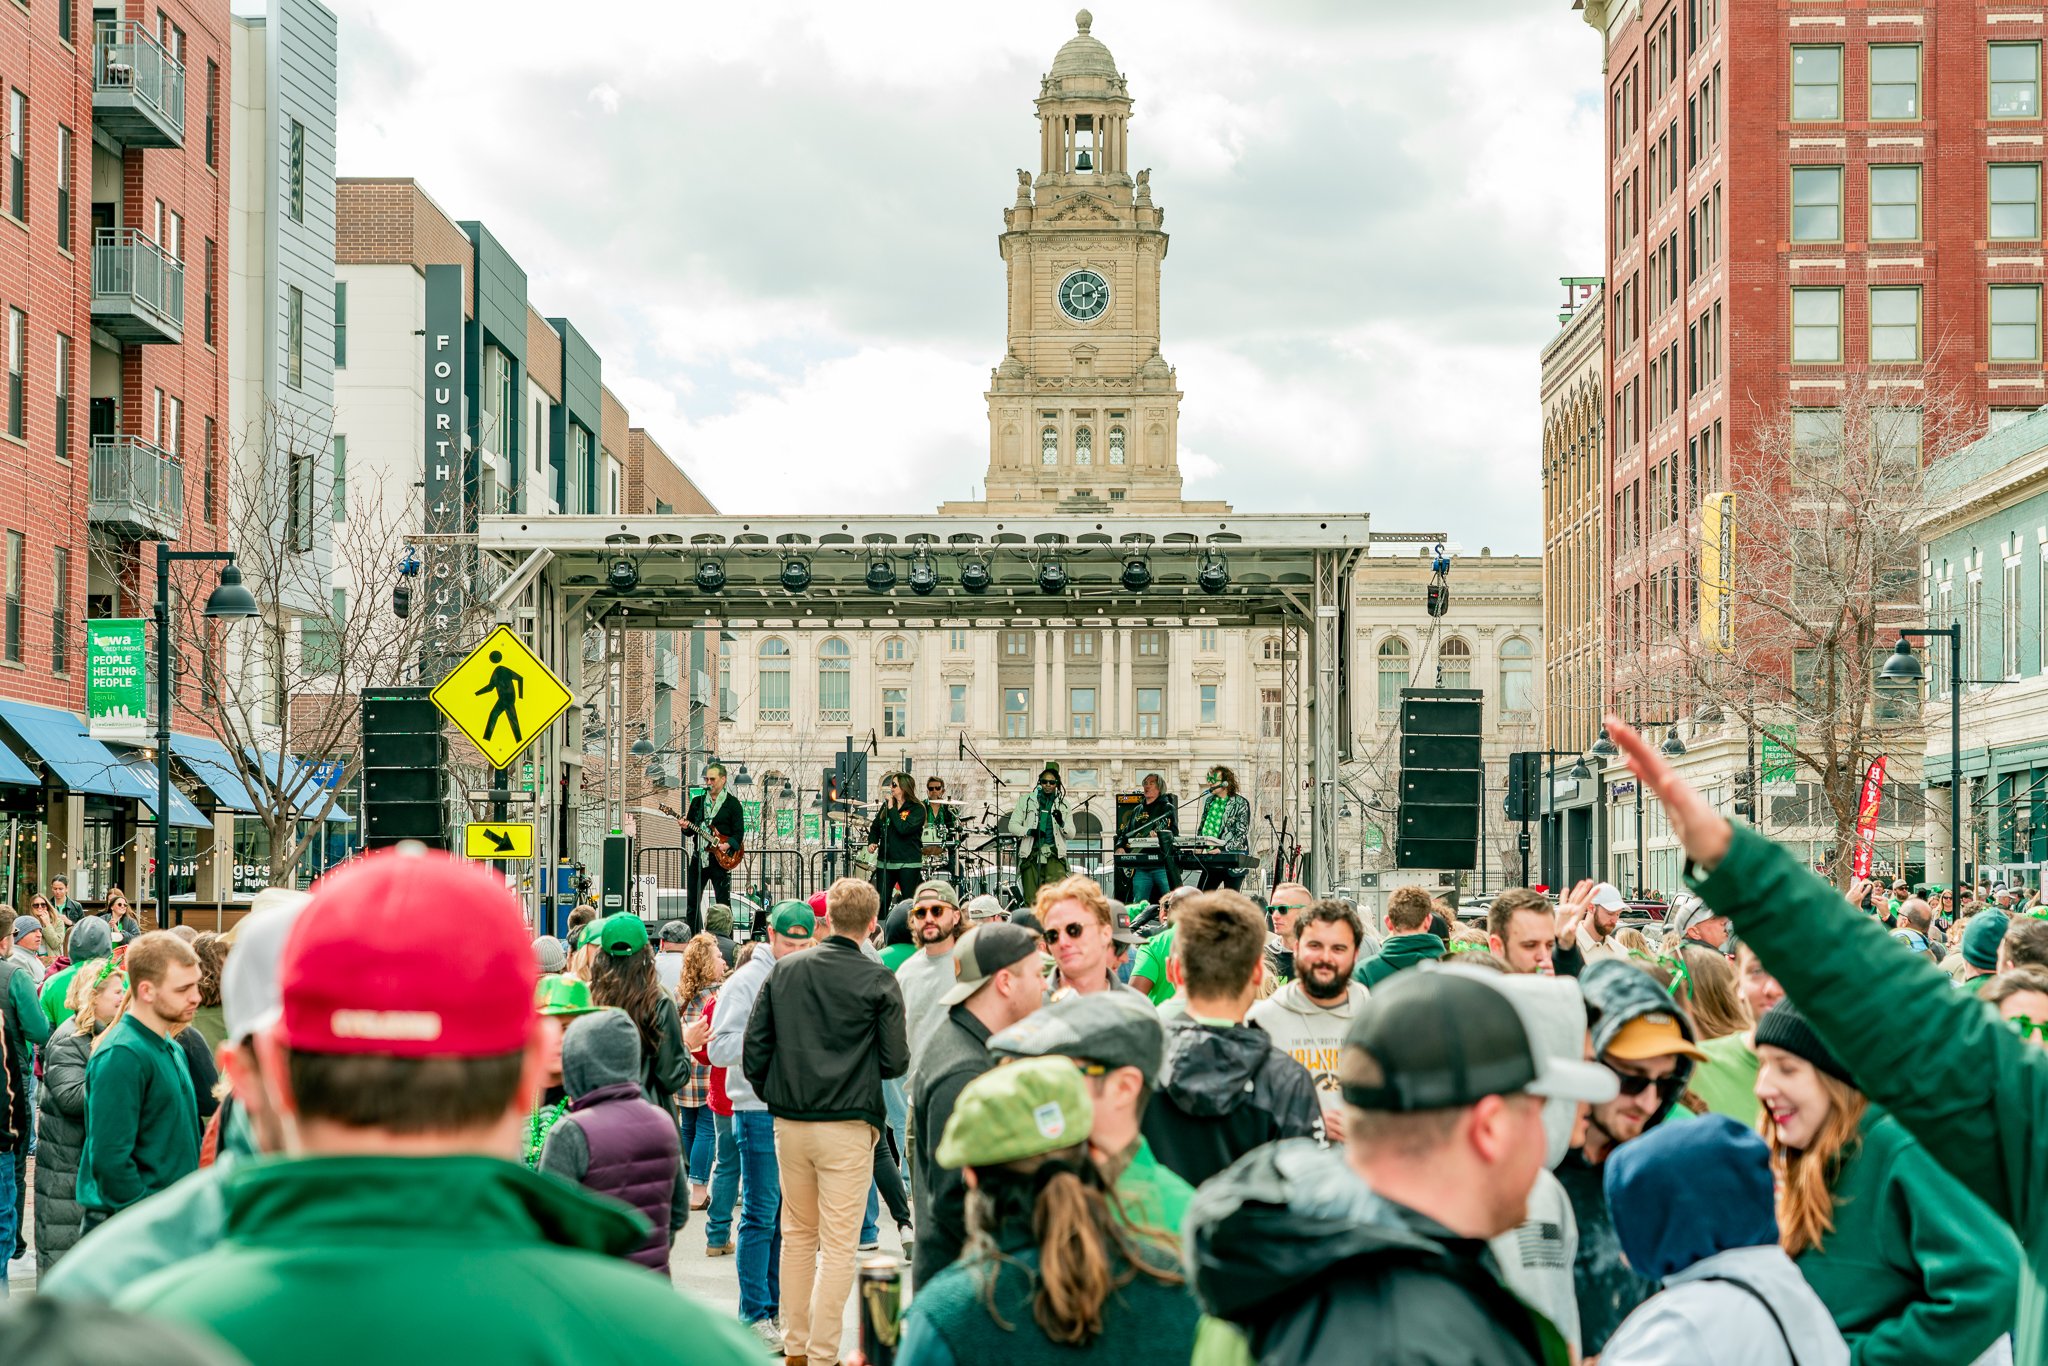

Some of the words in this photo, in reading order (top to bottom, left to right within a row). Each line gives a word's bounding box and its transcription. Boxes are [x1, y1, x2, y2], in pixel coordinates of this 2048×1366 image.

[434, 334, 451, 481] FOURTH
[434, 546, 450, 652] OURT
[93, 632, 132, 647] iowa
[93, 655, 132, 665] PEOPLE
[93, 666, 137, 676] HELPING
[93, 677, 132, 687] PEOPLE
[1867, 767, 1880, 802] HOT
[233, 864, 271, 879] gers
